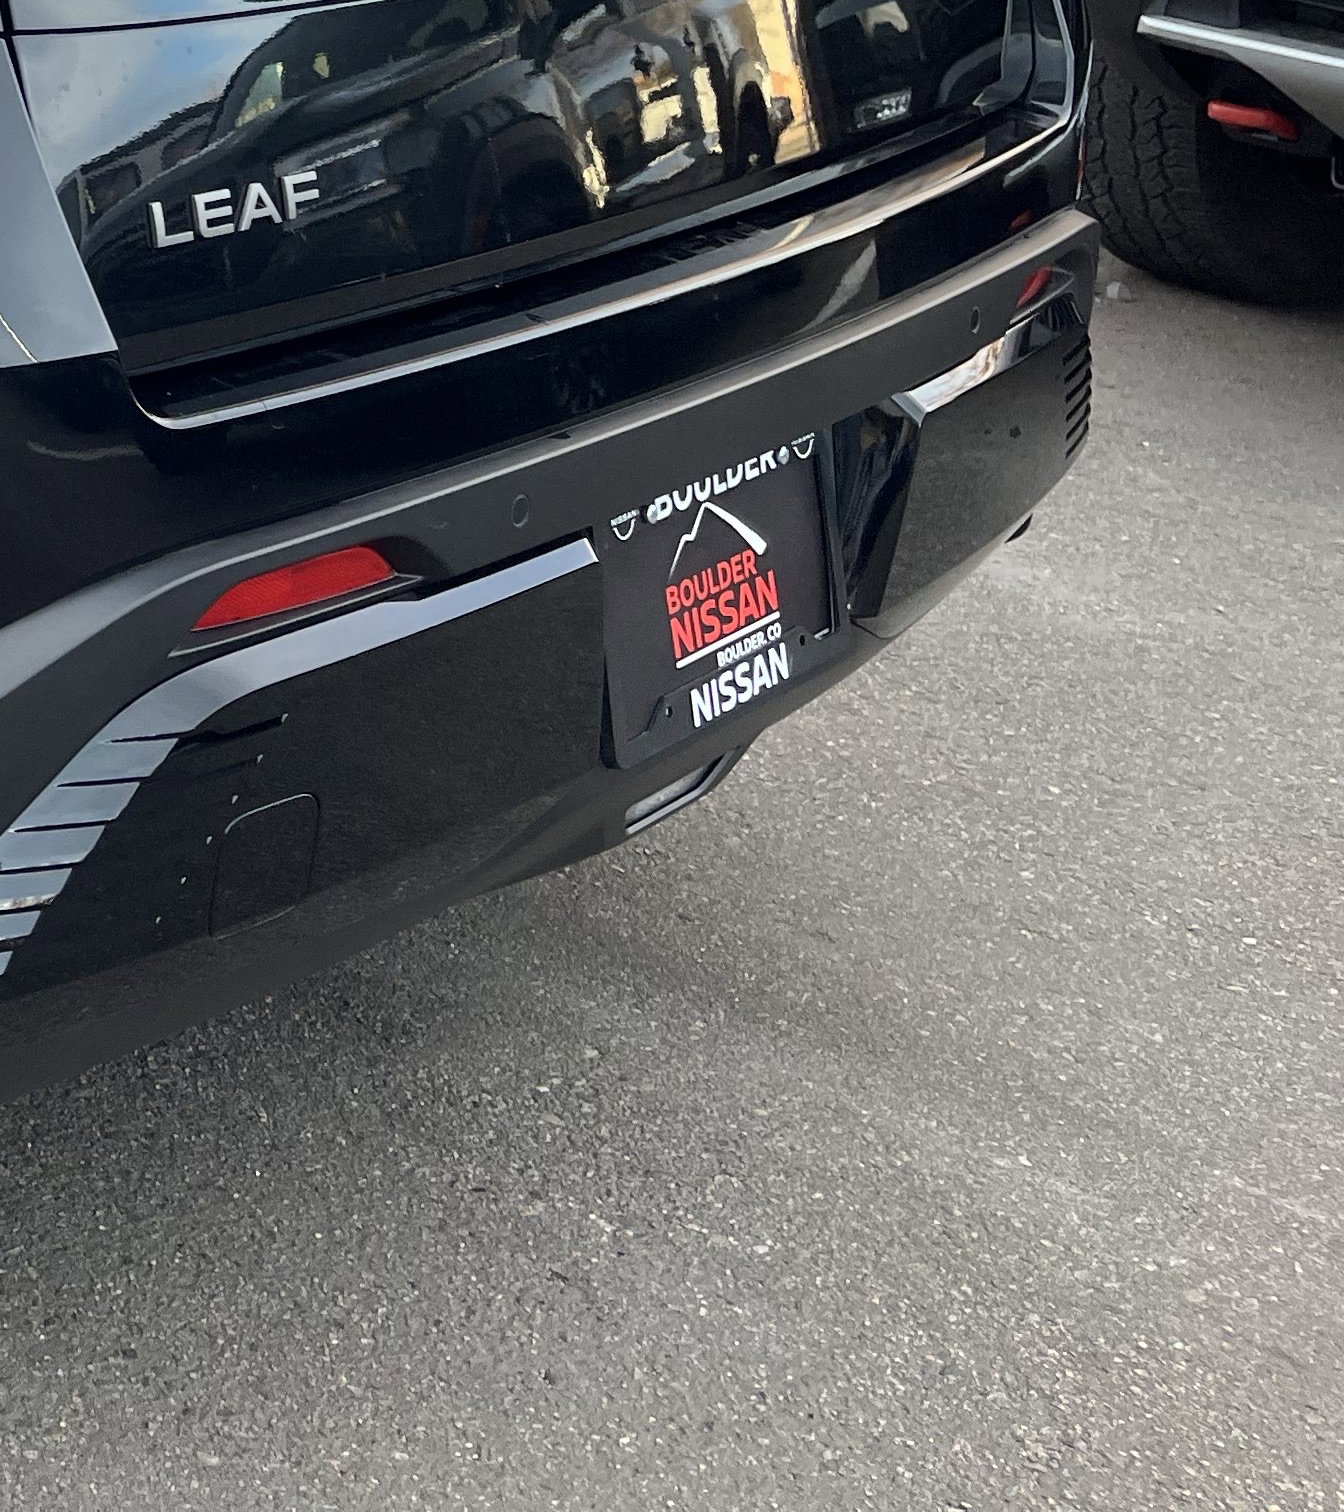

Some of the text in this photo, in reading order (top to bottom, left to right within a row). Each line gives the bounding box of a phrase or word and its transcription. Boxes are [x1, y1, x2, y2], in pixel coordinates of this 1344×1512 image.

[148, 170, 320, 249] LEAF
[665, 548, 757, 615] BOULDER
[670, 568, 779, 659] NISSAN
[690, 642, 790, 728] NISSAN
